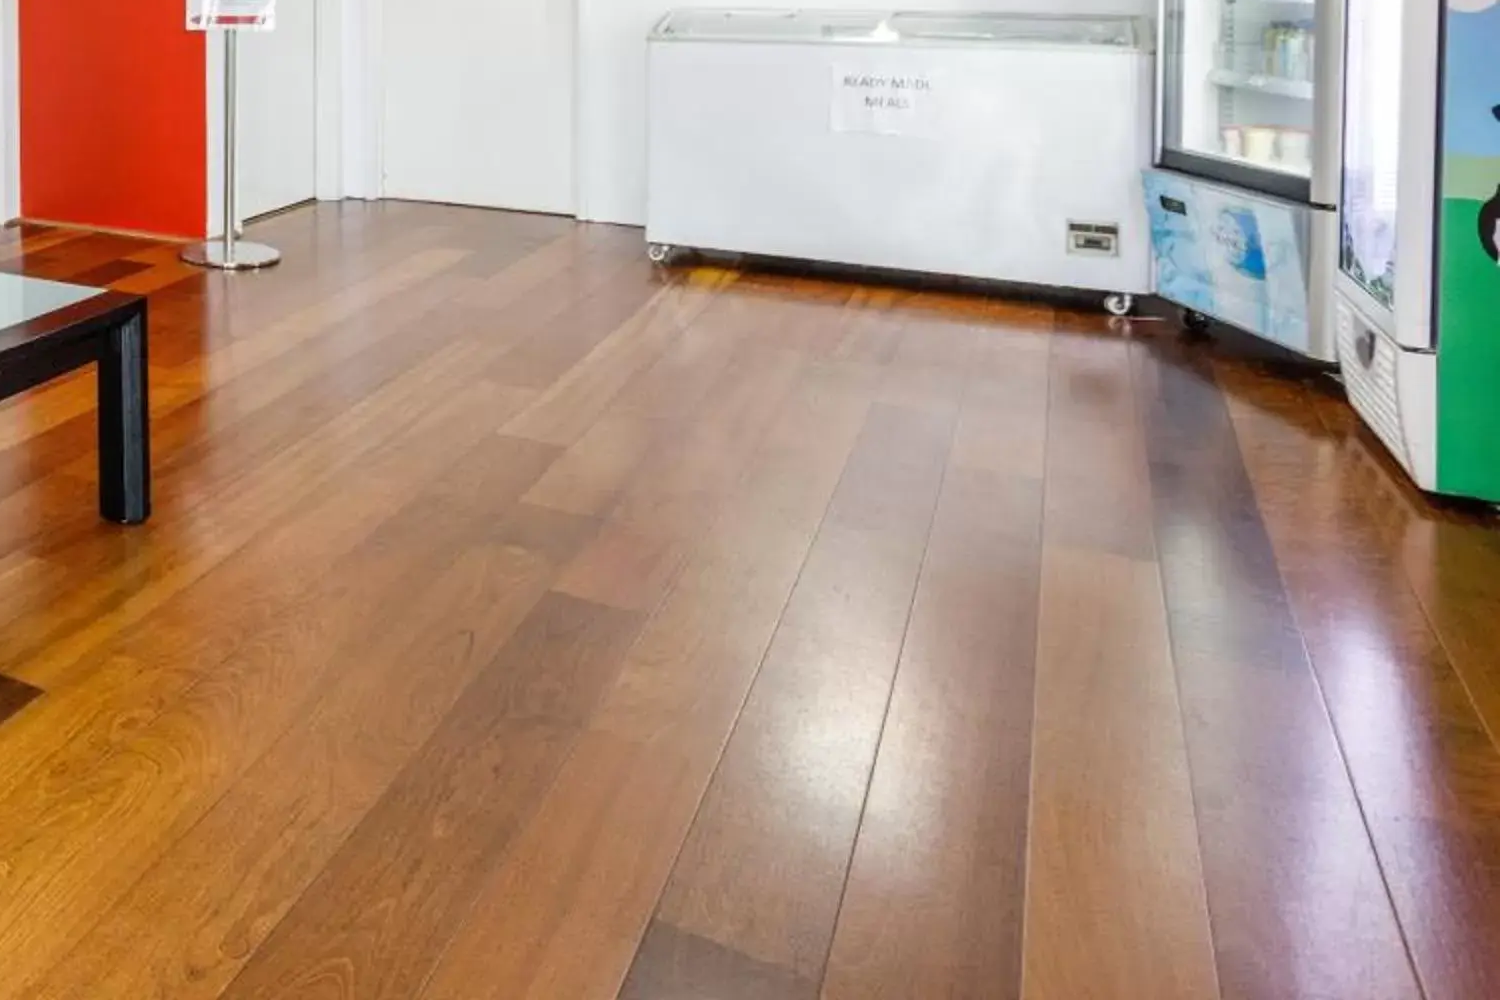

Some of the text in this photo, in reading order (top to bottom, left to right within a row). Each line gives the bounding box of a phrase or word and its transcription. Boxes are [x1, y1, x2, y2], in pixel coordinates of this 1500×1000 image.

[843, 75, 932, 90] READY MADE
[864, 96, 909, 108] MEALS
